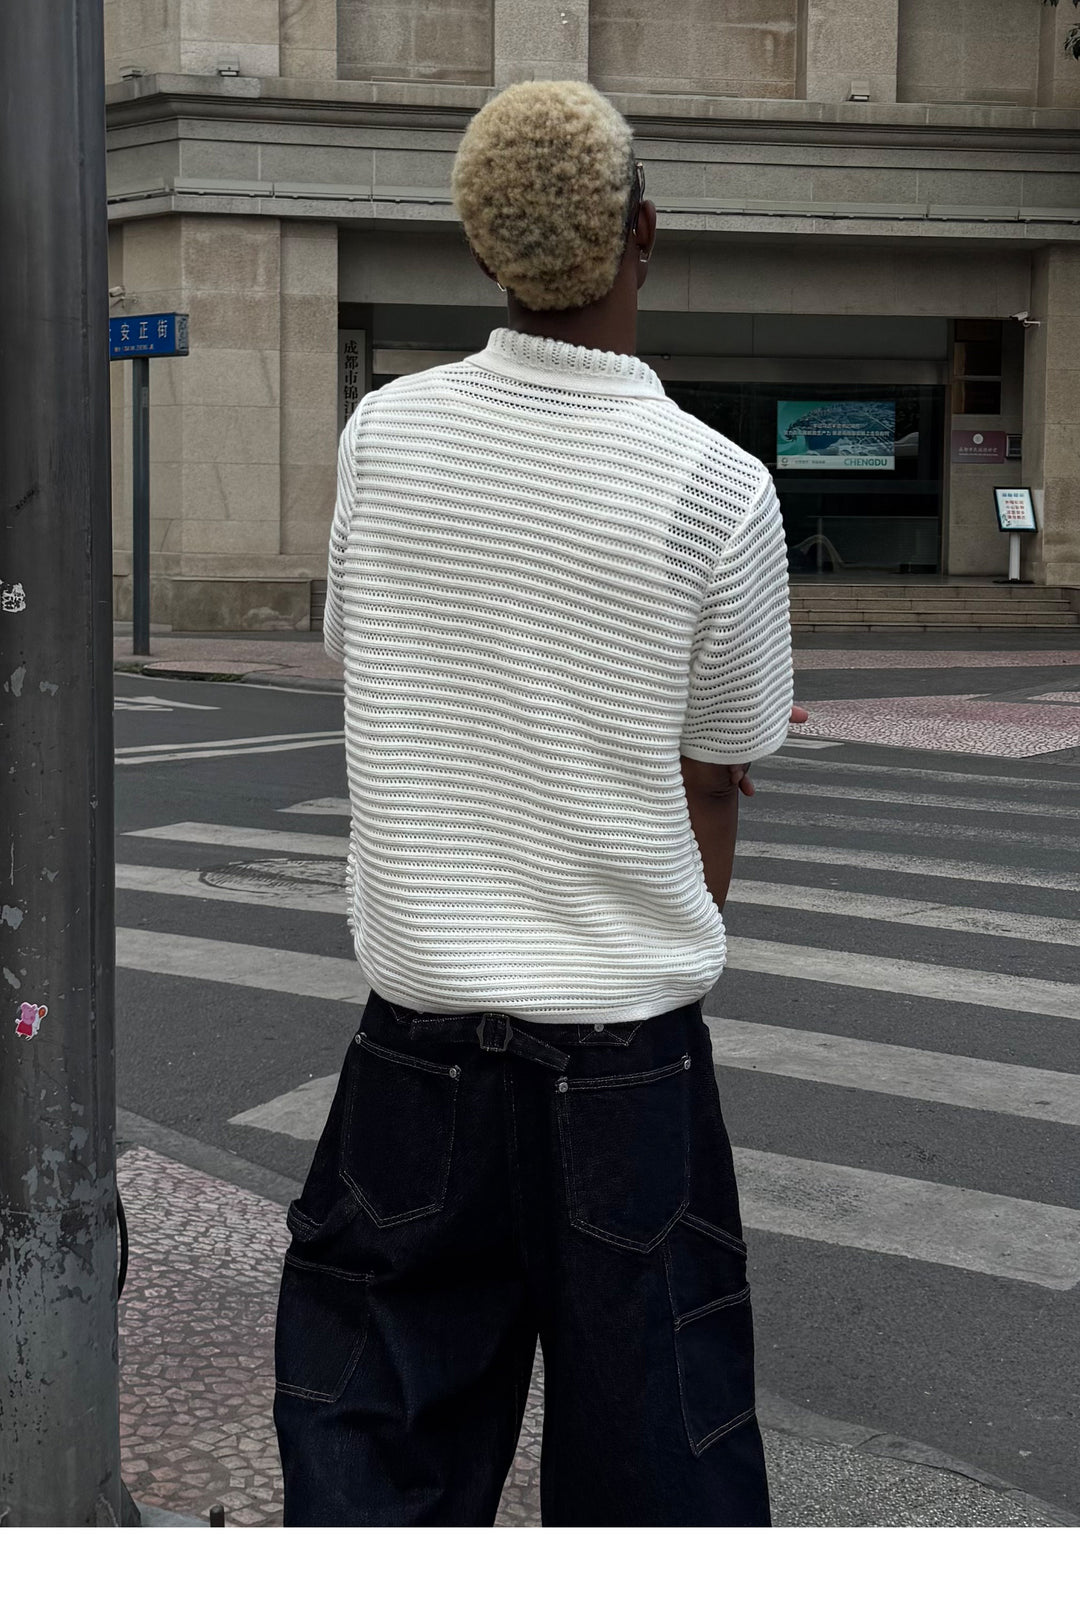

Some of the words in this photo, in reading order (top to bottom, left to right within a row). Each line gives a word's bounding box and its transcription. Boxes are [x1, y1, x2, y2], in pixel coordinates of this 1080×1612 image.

[109, 319, 168, 342] 安正街
[343, 340, 359, 424] 成都市锦江
[844, 458, 888, 467] CHENGDU
